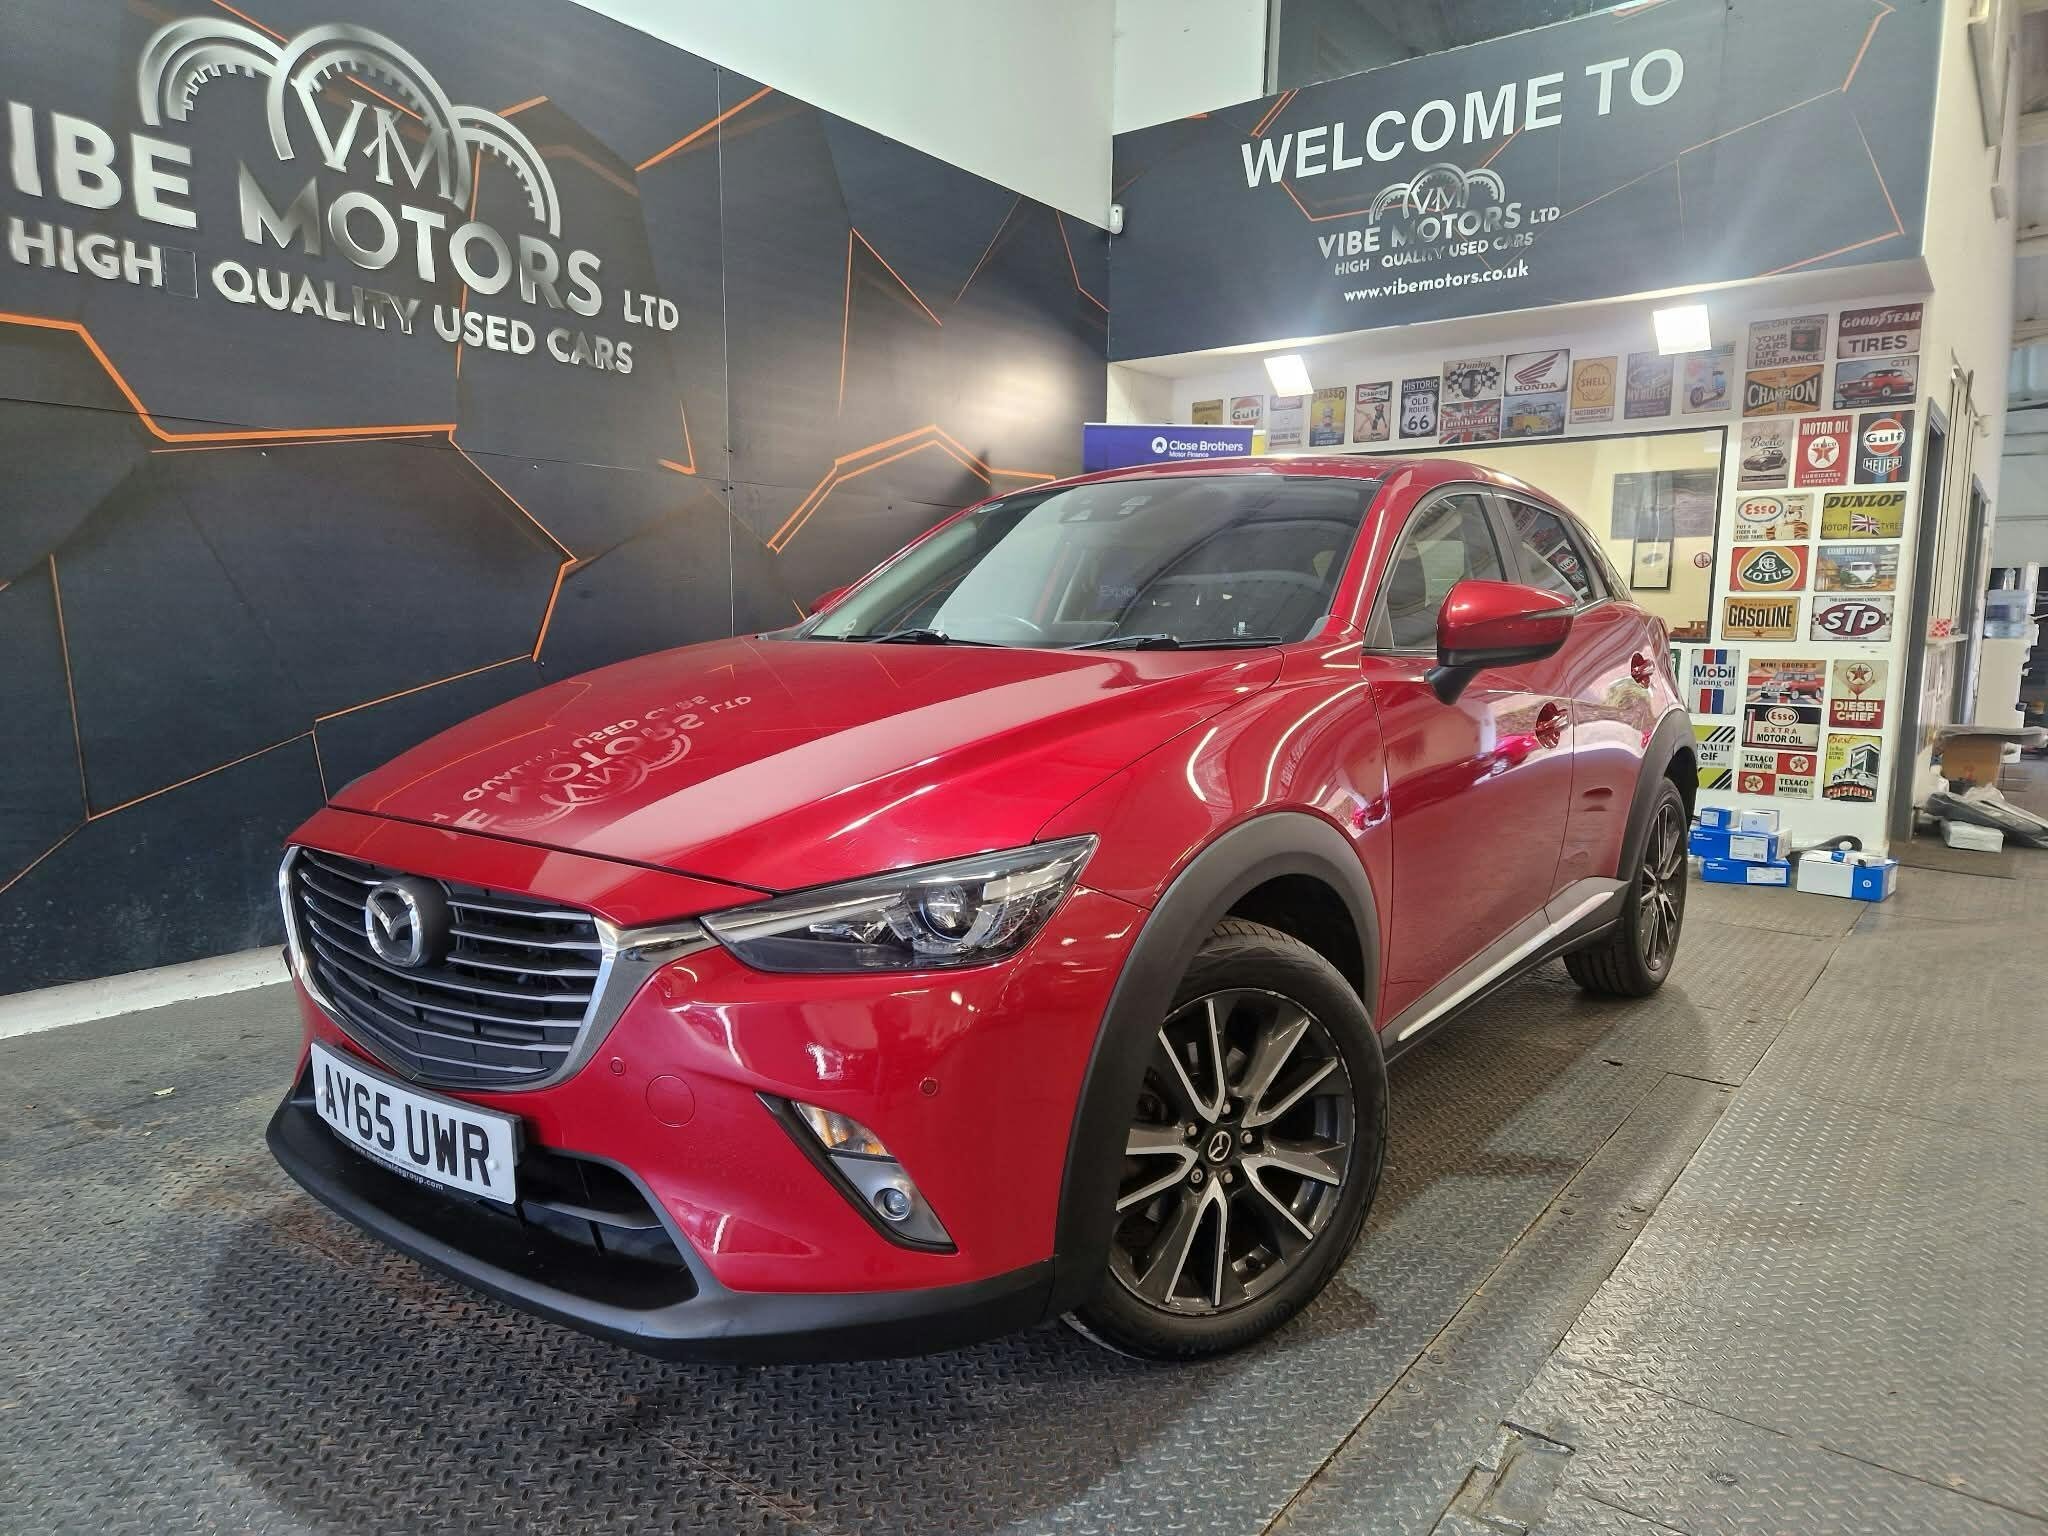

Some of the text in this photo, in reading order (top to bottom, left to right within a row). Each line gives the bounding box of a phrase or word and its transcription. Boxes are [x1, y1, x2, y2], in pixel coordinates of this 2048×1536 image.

[1240, 48, 1685, 189] WELCOME TO
[8, 101, 680, 332] IBE MOTORS LTD
[1317, 202, 1561, 260] VIBE MOTORS LTD
[1334, 231, 1535, 276] HIGH QUALITY USED CARS
[1344, 259, 1529, 302] www.vibemotors.co.uk
[8, 217, 634, 375] HIGH QUALITY USED CARS
[1841, 311, 1921, 329] GOODYEAR
[1755, 333, 1788, 343] YOUR
[1848, 334, 1908, 353] TIRES
[1755, 341, 1788, 351] CARS
[1755, 350, 1779, 359] LIFE
[1755, 353, 1819, 368] INSURANCE
[1456, 360, 1492, 371] Dunlop
[1403, 379, 1438, 392] HISTORIC
[1514, 382, 1559, 392] HONDA
[1580, 376, 1607, 387] SHELL
[1359, 389, 1389, 398] CHAMPION
[1747, 377, 1818, 407] CHAMPION
[1411, 397, 1428, 406] OLD
[1232, 408, 1261, 420] Gulf
[1408, 405, 1431, 413] ROUTE
[1407, 415, 1429, 431] 66
[1802, 419, 1849, 436] MOTOR OIL
[1866, 431, 1905, 444] Gulf
[1169, 440, 1243, 452] Close Brothers
[1864, 457, 1902, 472] HEUER
[1825, 494, 1905, 509] DUNLOP
[1744, 503, 1777, 516] Esso
[1746, 567, 1792, 581] LOTUS
[1728, 604, 1794, 629] GASOLINE
[1823, 605, 1881, 634] STP
[1693, 664, 1736, 678] Mobil
[1692, 677, 1736, 688] Racing oil
[1832, 701, 1881, 712] DIESEL
[1770, 711, 1796, 722] Esso
[1836, 711, 1876, 722] CHIEF
[1763, 727, 1798, 735] EXTRA
[1756, 733, 1804, 745] MOTOR OIL
[1696, 743, 1732, 752] ENAULT
[1700, 751, 1719, 761] elf
[1745, 754, 1775, 764] TEXACO
[1779, 778, 1809, 787] TEXACO
[1778, 786, 1797, 794] MOTOR
[325, 1064, 396, 1152] AY65
[404, 1103, 493, 1188] UWR
